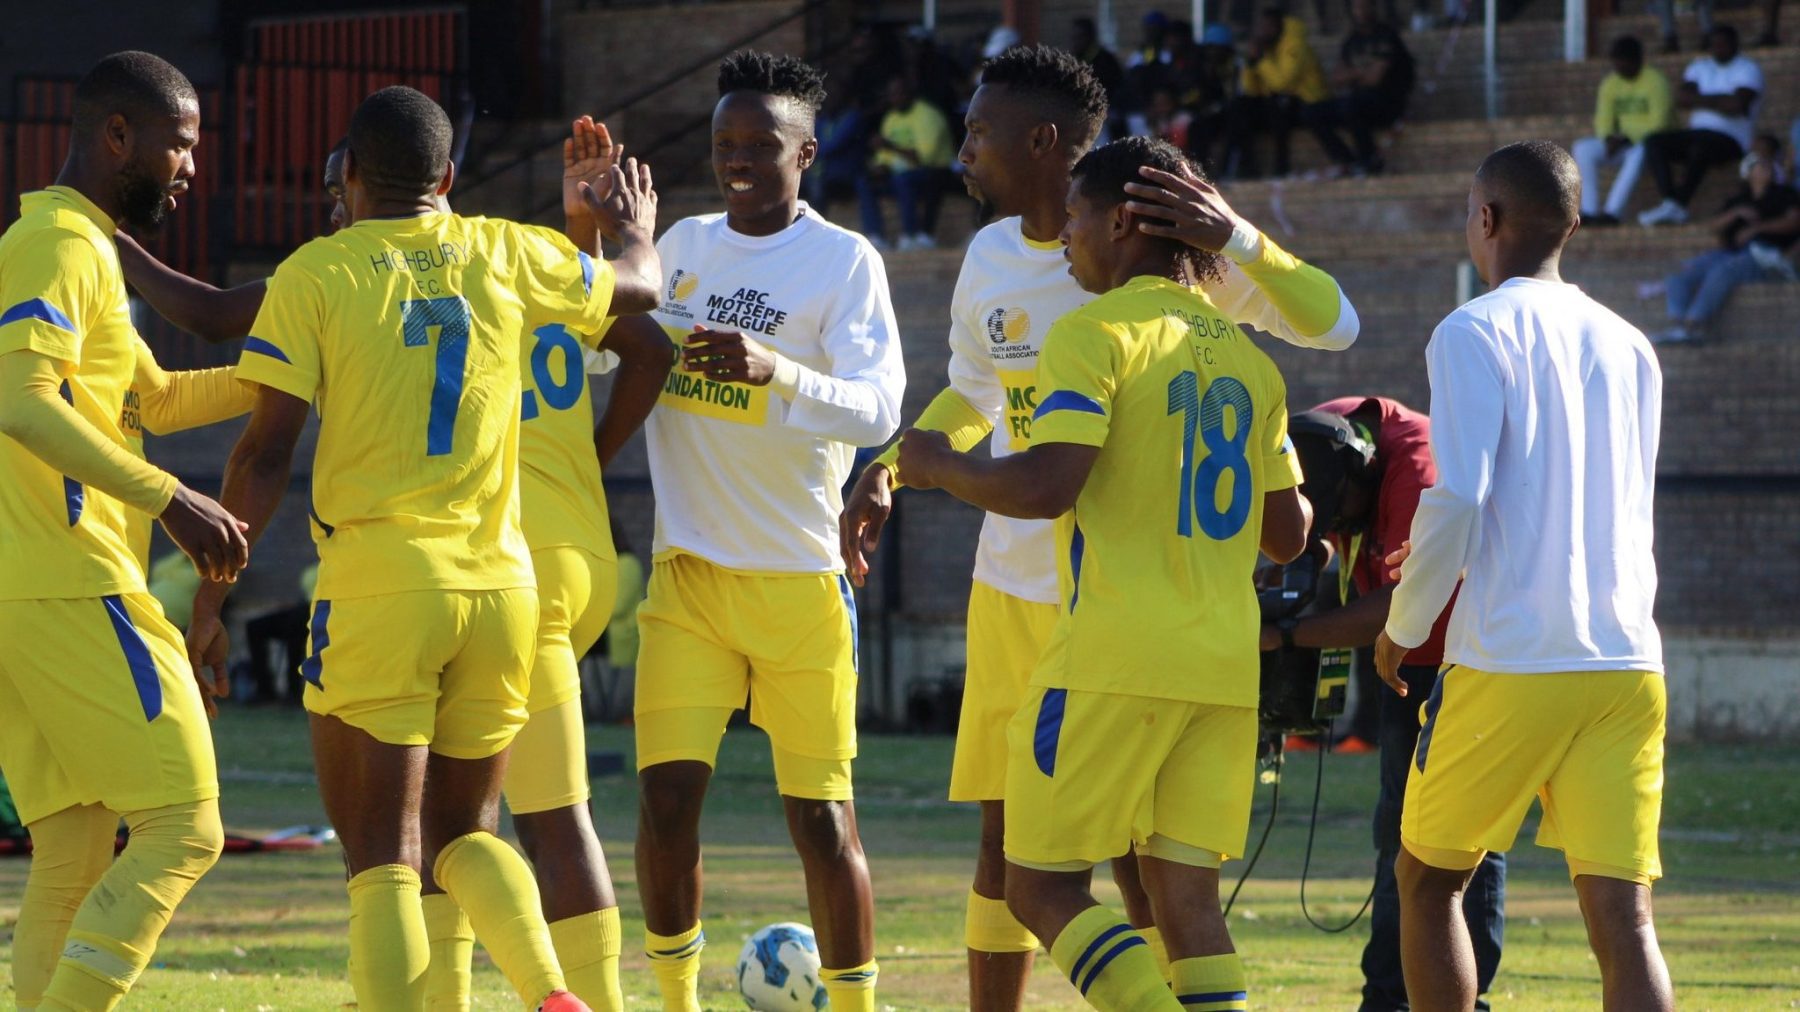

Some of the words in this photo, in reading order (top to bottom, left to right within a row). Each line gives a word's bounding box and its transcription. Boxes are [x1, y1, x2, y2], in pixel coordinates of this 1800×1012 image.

[370, 242, 468, 274] HIGHBURY
[417, 279, 445, 296] F.C.
[732, 287, 770, 305] ABC
[706, 294, 788, 325] MOTSEPE
[706, 310, 778, 336] LEAGUE
[1005, 350, 1040, 360] ASSOCIATIO
[400, 295, 471, 456] 7
[123, 390, 140, 410] MO
[665, 372, 751, 410] UNDATION
[122, 409, 140, 430] FOU
[1167, 370, 1253, 541] 18
